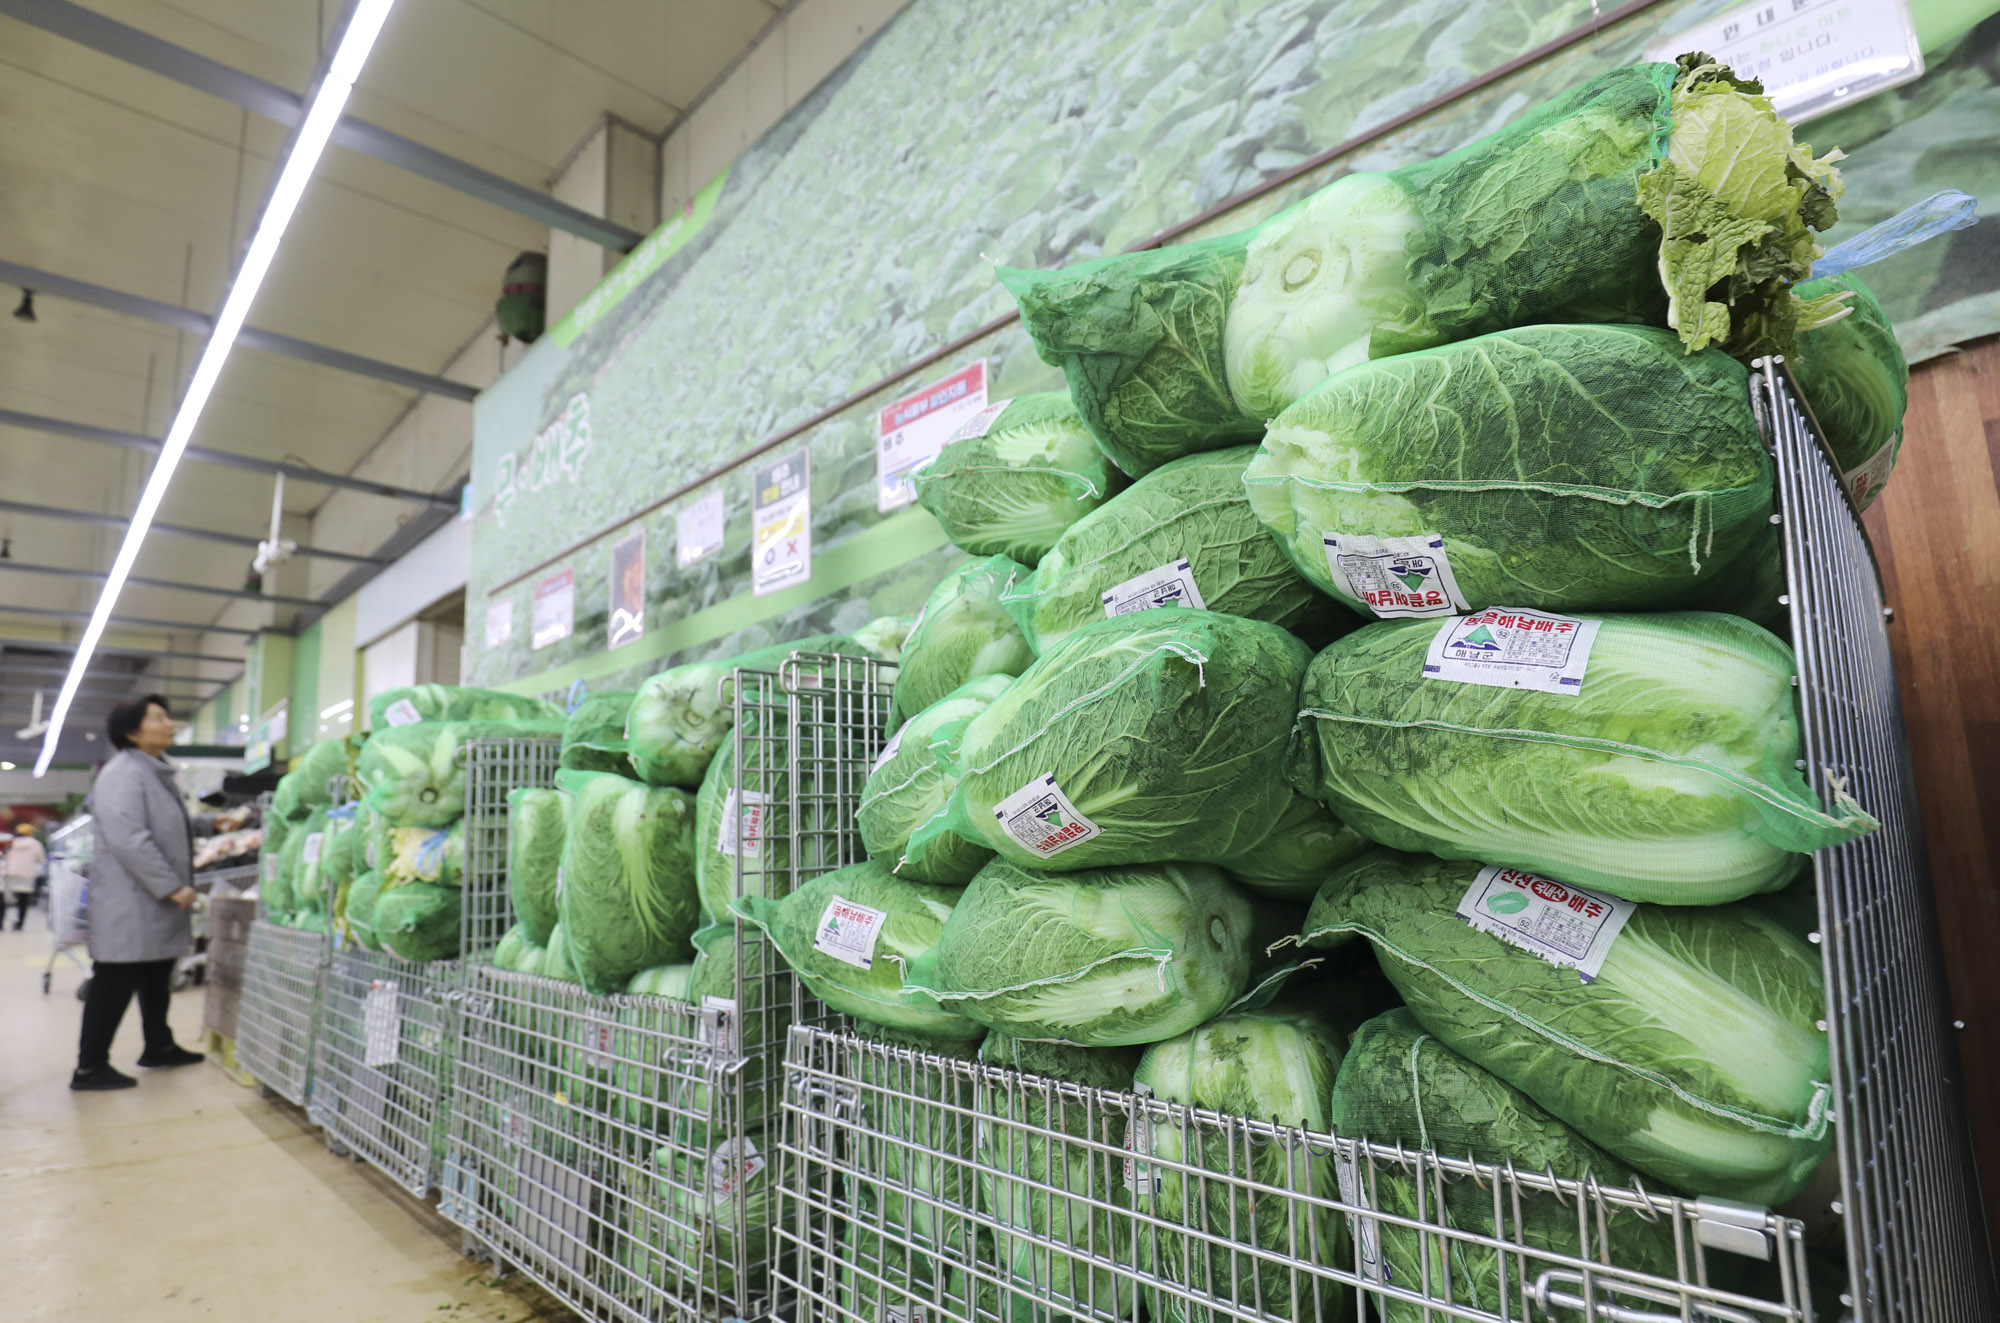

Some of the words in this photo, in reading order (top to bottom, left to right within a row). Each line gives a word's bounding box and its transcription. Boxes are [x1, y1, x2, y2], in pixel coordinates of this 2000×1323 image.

[1501, 869, 1531, 889] 신선
[1535, 881, 1567, 900] 국내산
[1568, 894, 1603, 918] 배추
